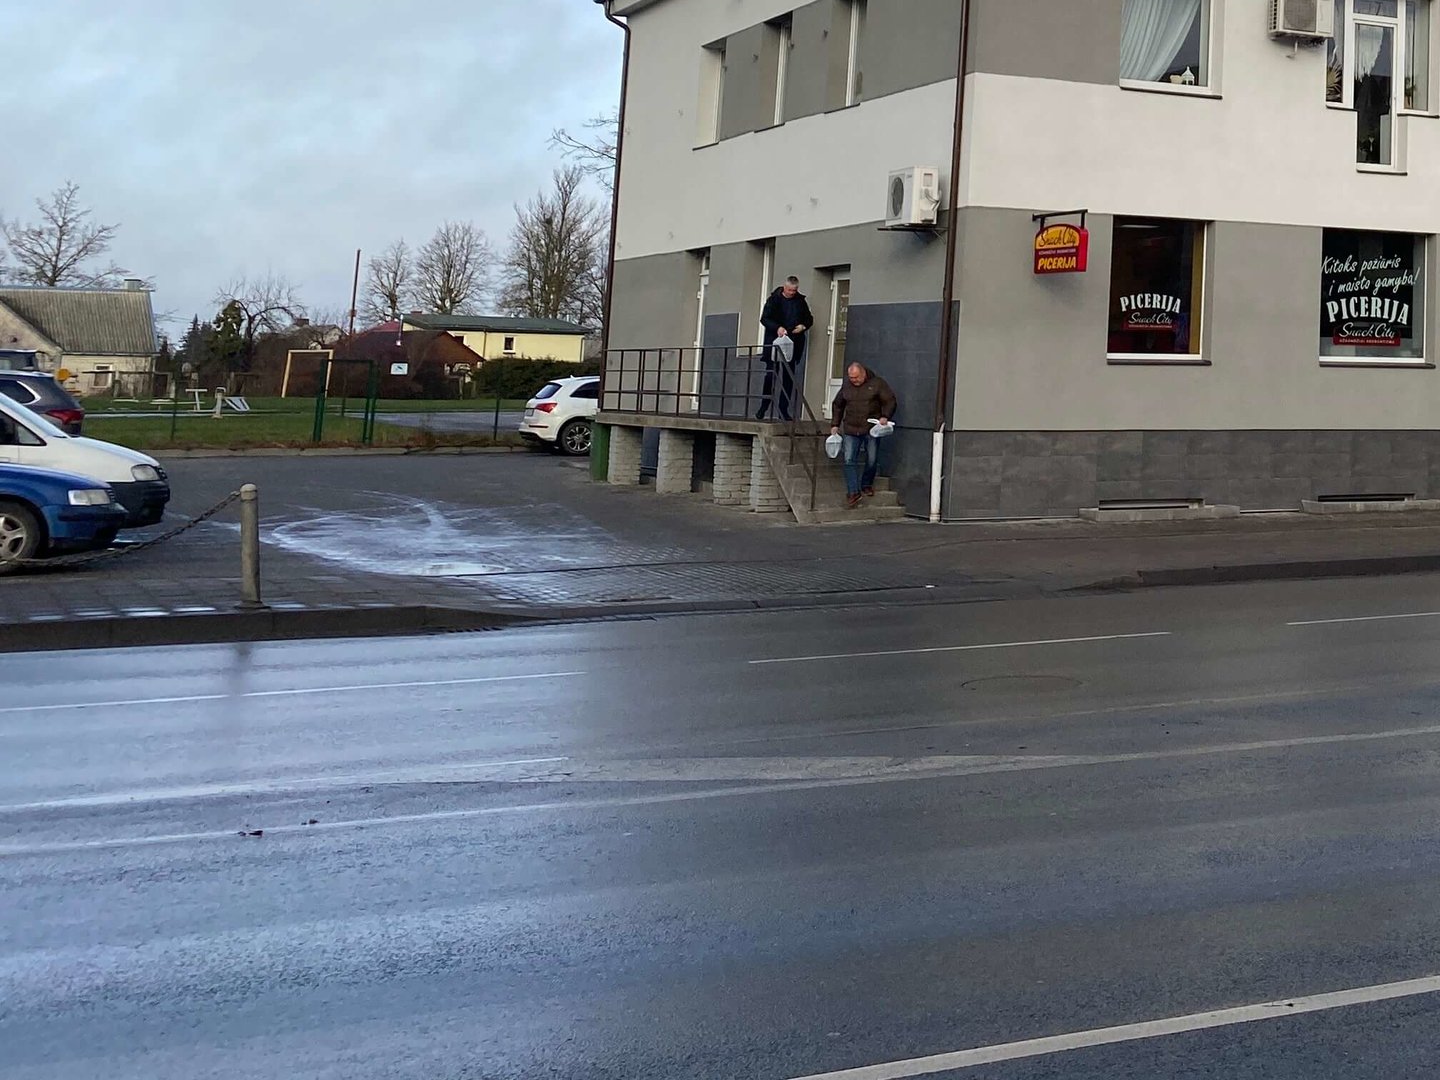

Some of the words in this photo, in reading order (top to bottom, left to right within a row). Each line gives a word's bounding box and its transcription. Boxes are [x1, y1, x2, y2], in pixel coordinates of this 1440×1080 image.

[1037, 256, 1077, 270] PICERIJA
[1321, 254, 1358, 274] Kitoks
[1337, 276, 1371, 294] maisto
[1120, 293, 1181, 314] PICERIJA
[1326, 296, 1410, 325] PICERIJA
[1374, 322, 1395, 339] City
